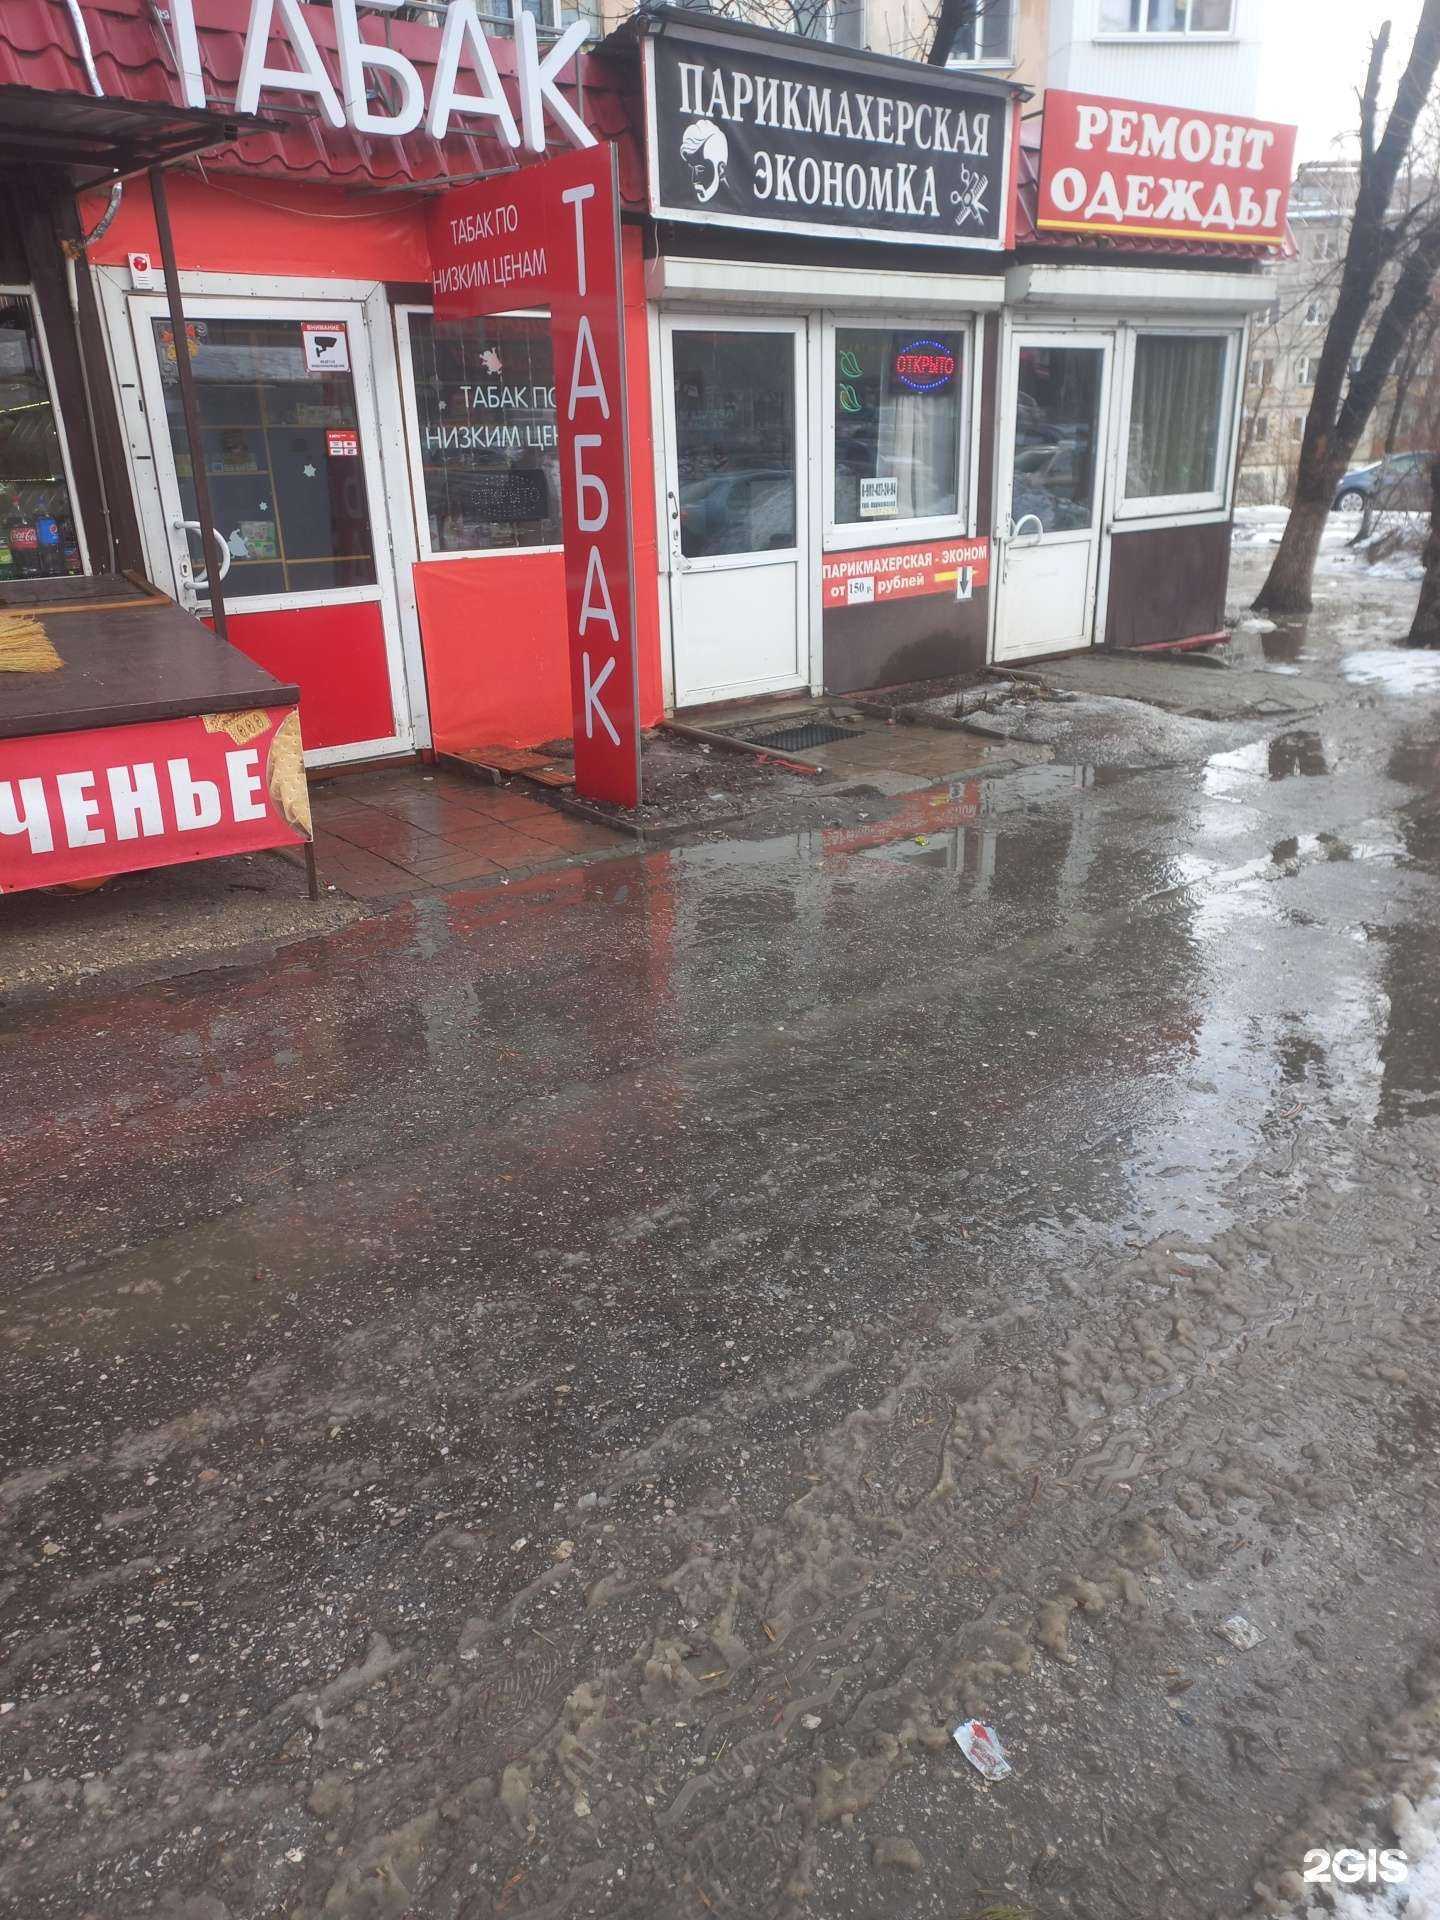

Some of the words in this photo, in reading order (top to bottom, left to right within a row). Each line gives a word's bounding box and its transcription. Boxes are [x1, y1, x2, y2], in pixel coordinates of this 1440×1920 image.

[677, 61, 991, 157] ПАРИКМАХЕРСКАЯ
[1075, 104, 1275, 171] РЕМОНТ
[1050, 166, 1283, 231] ОДЕЖДЫ
[450, 209, 495, 246] ТАБАК
[495, 203, 518, 236] ПО
[432, 259, 491, 296] НИЗКИМ
[492, 246, 548, 289] ЦЕНАМ
[896, 355, 955, 374] ОТКРЫТО
[459, 385, 530, 410] ТАБАК
[425, 424, 522, 451] НИЗКИМ
[562, 183, 620, 747] ТАБАК
[822, 553, 933, 580] ПАРИКМАХЕРСКАЯ
[942, 545, 987, 564] ЭКОНОМ
[830, 585, 846, 597] от
[849, 582, 865, 594] 150
[877, 573, 925, 595] рублей
